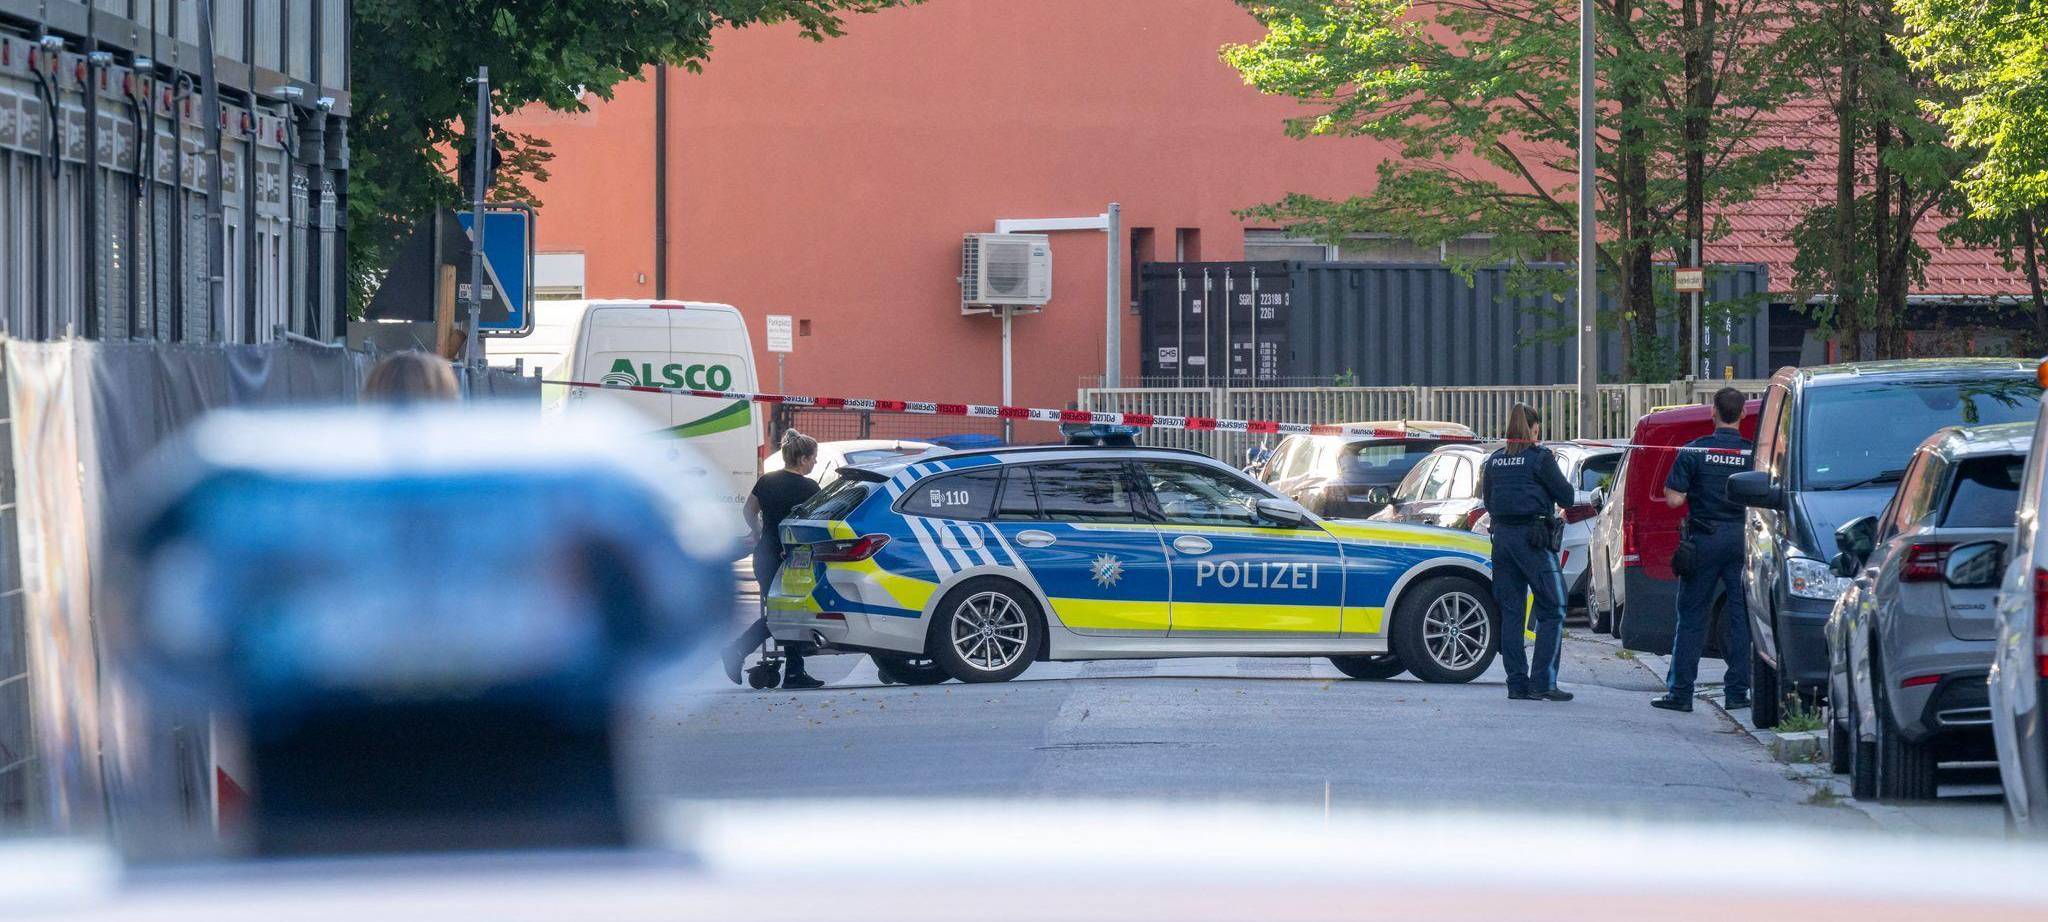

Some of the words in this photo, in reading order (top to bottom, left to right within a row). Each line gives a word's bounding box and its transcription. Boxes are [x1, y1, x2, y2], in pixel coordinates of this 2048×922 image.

[602, 359, 731, 391] ALSCO
[1492, 457, 1525, 466] POLIZEI
[1705, 454, 1745, 466] POLIZEI
[946, 491, 969, 505] 110
[1196, 560, 1318, 589] POLIZEI
